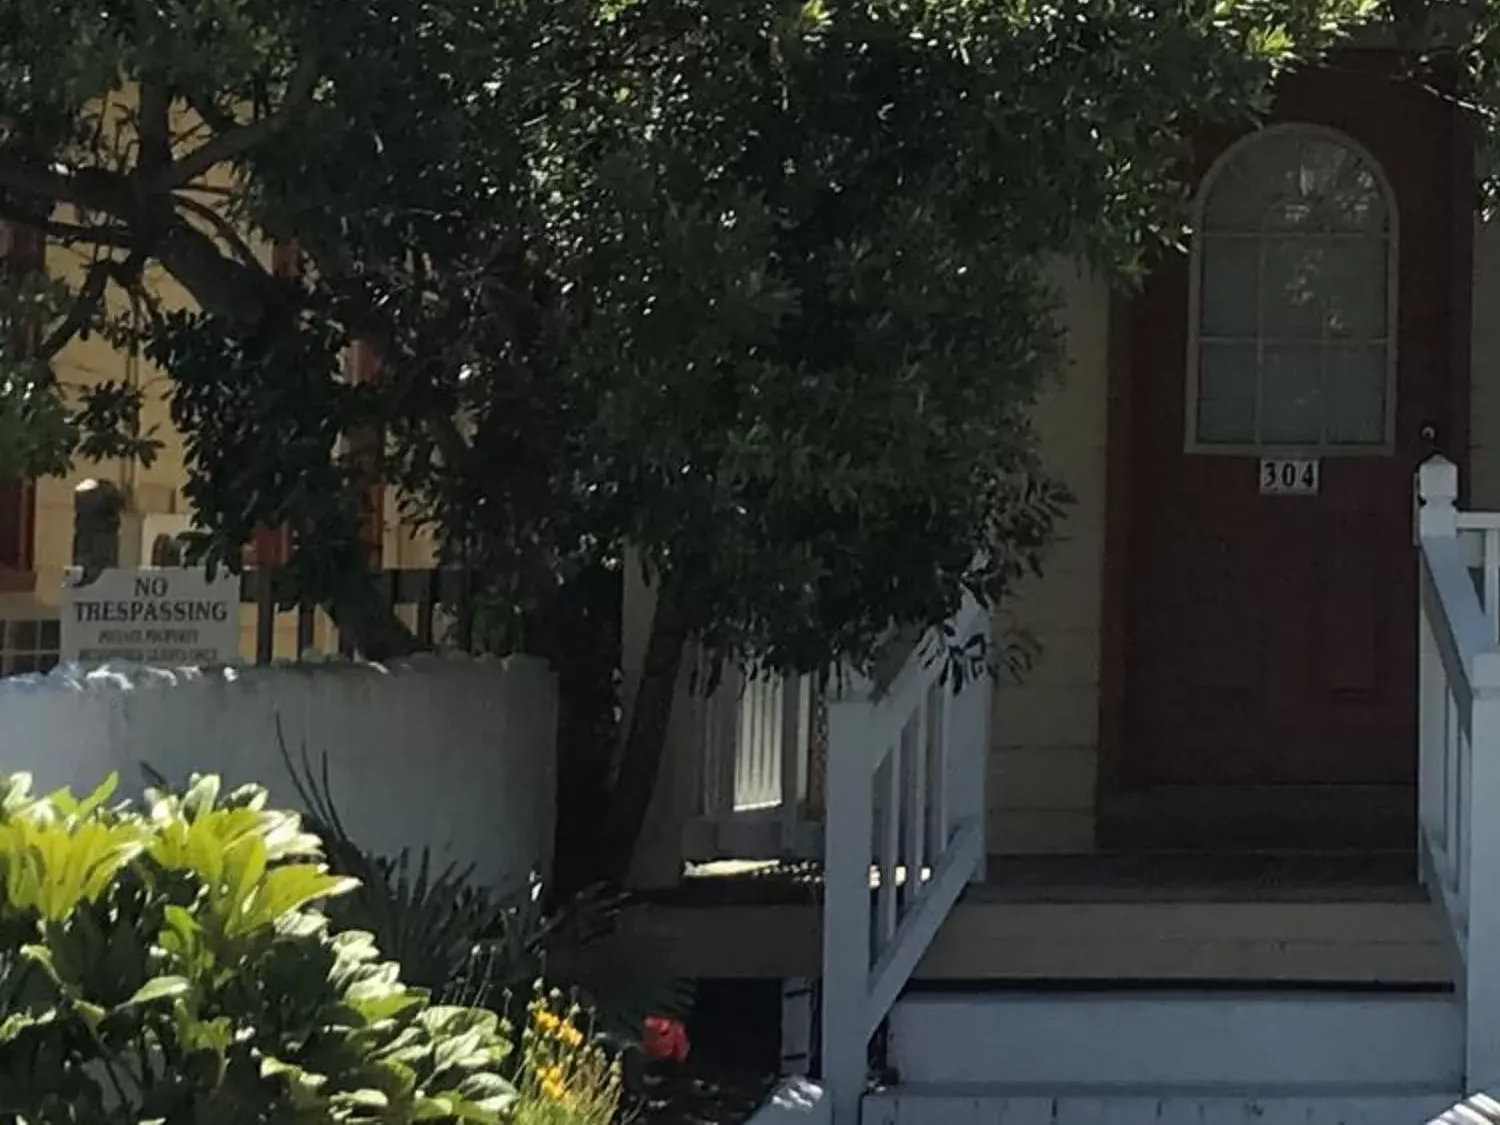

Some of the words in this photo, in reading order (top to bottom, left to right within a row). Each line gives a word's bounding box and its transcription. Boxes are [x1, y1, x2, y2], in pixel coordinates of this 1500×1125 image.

[1264, 462, 1314, 488] 304
[134, 577, 168, 597] NO
[74, 601, 227, 622] TRESPASSING
